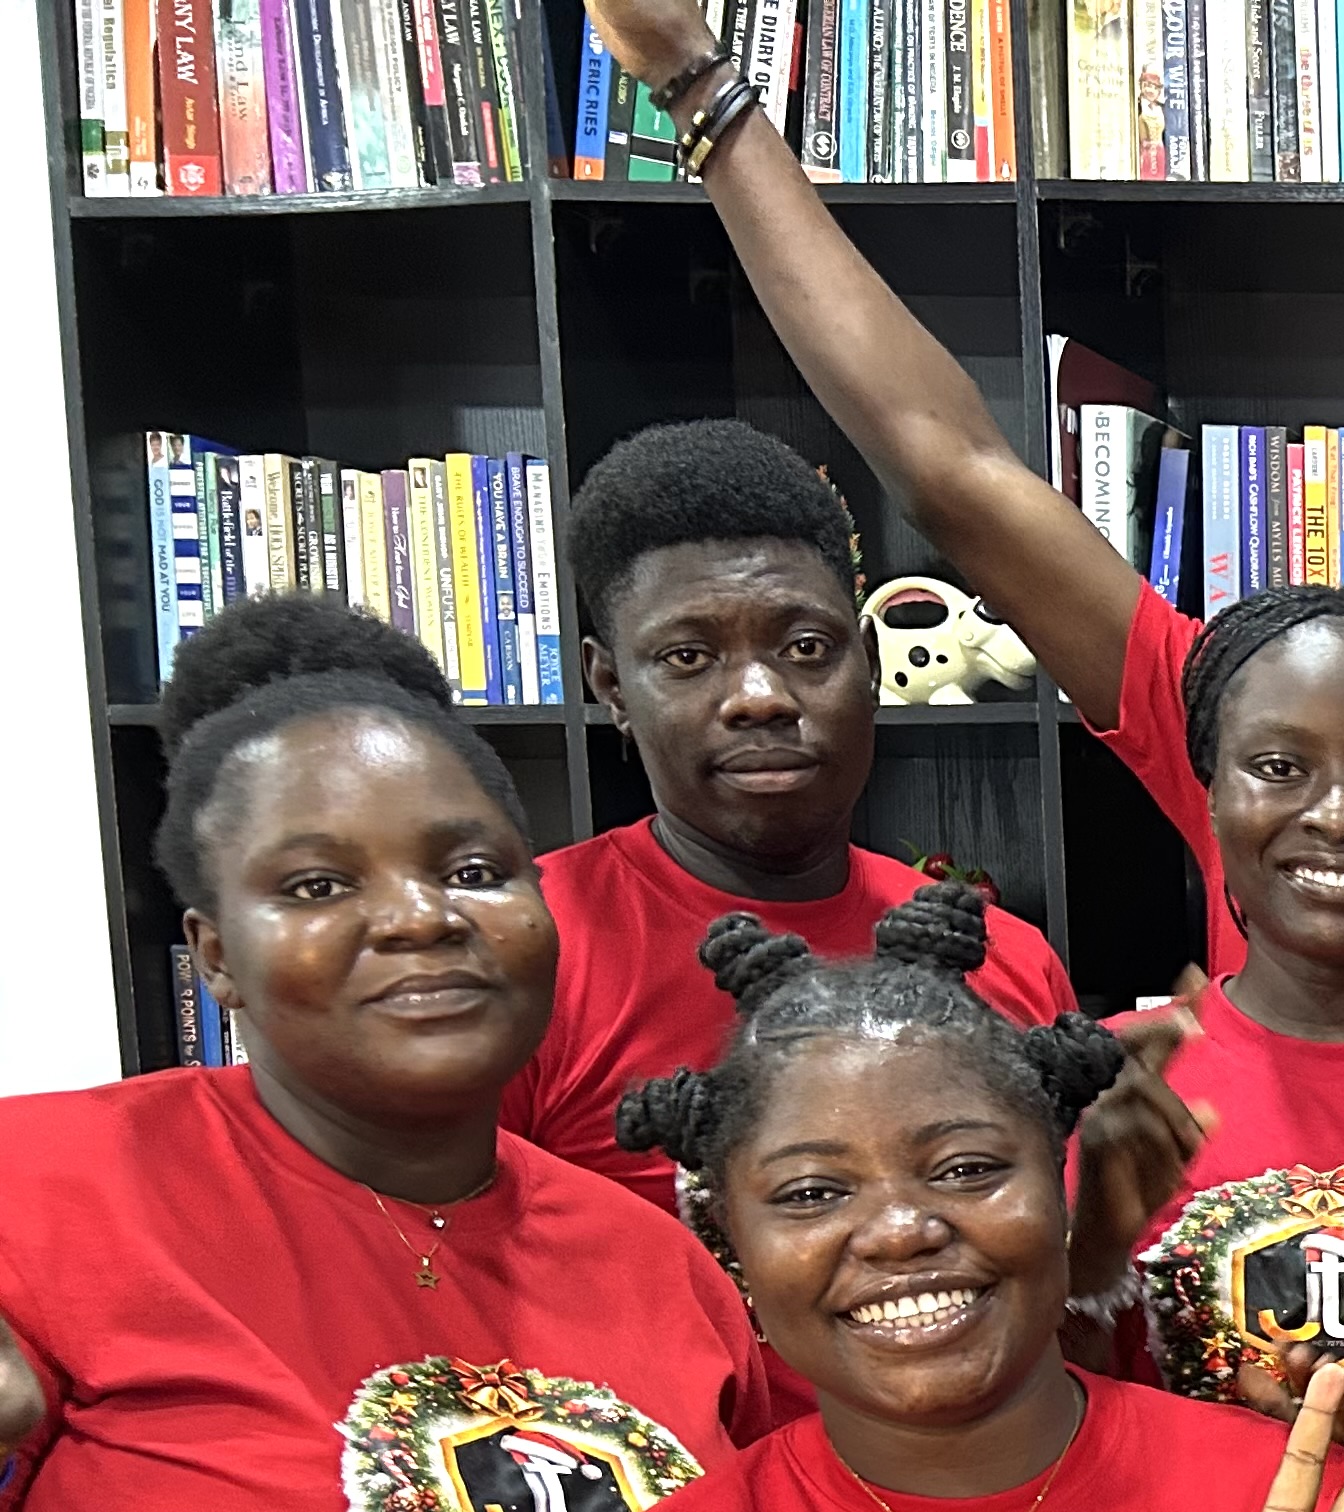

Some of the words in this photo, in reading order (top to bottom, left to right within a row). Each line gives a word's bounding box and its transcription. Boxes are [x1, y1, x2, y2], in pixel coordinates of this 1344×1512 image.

[443, 15, 462, 45] LAW
[734, 8, 747, 29] THE
[1252, 26, 1263, 45] and
[731, 32, 745, 51] LAW
[757, 15, 777, 66] DIARY
[176, 36, 198, 85] LAW
[586, 59, 602, 97] ERIC
[818, 73, 833, 121] CONTRACT
[1169, 66, 1186, 110] WIFE
[584, 100, 600, 136] RIES
[1248, 434, 1257, 456] RICH
[510, 466, 523, 498] BRAVE
[1269, 435, 1281, 493] WISDOM
[153, 479, 165, 506] GOD
[293, 471, 305, 512] SECRETS
[492, 472, 504, 498] YOU
[531, 472, 546, 534] MANAGING
[1291, 468, 1303, 525] PATRICK
[221, 490, 237, 547] Battlefield
[494, 501, 506, 530] HAVE
[513, 500, 525, 543] ENOUGH
[1248, 483, 1260, 535] CASHFLOW
[1307, 504, 1325, 539] THE
[269, 524, 283, 551] HOLY
[296, 526, 307, 560] SECRET
[457, 530, 467, 542] OF
[516, 546, 526, 558] TO
[1271, 520, 1282, 562] MYLES
[157, 545, 169, 571] MAD
[497, 544, 509, 579] BRAIN
[1249, 536, 1260, 589] QUADRANT
[1292, 528, 1304, 586] LENCION
[1307, 546, 1325, 578] 10X
[159, 572, 170, 586] AT
[393, 585, 409, 609] God
[517, 560, 530, 608] SUCCEED
[160, 588, 171, 612] YOU
[537, 572, 551, 630] EMOTIONS
[503, 630, 515, 671] CARSON
[539, 643, 551, 686] MEYER
[550, 646, 561, 683] JOYCE
[180, 999, 197, 1042] POINTS
